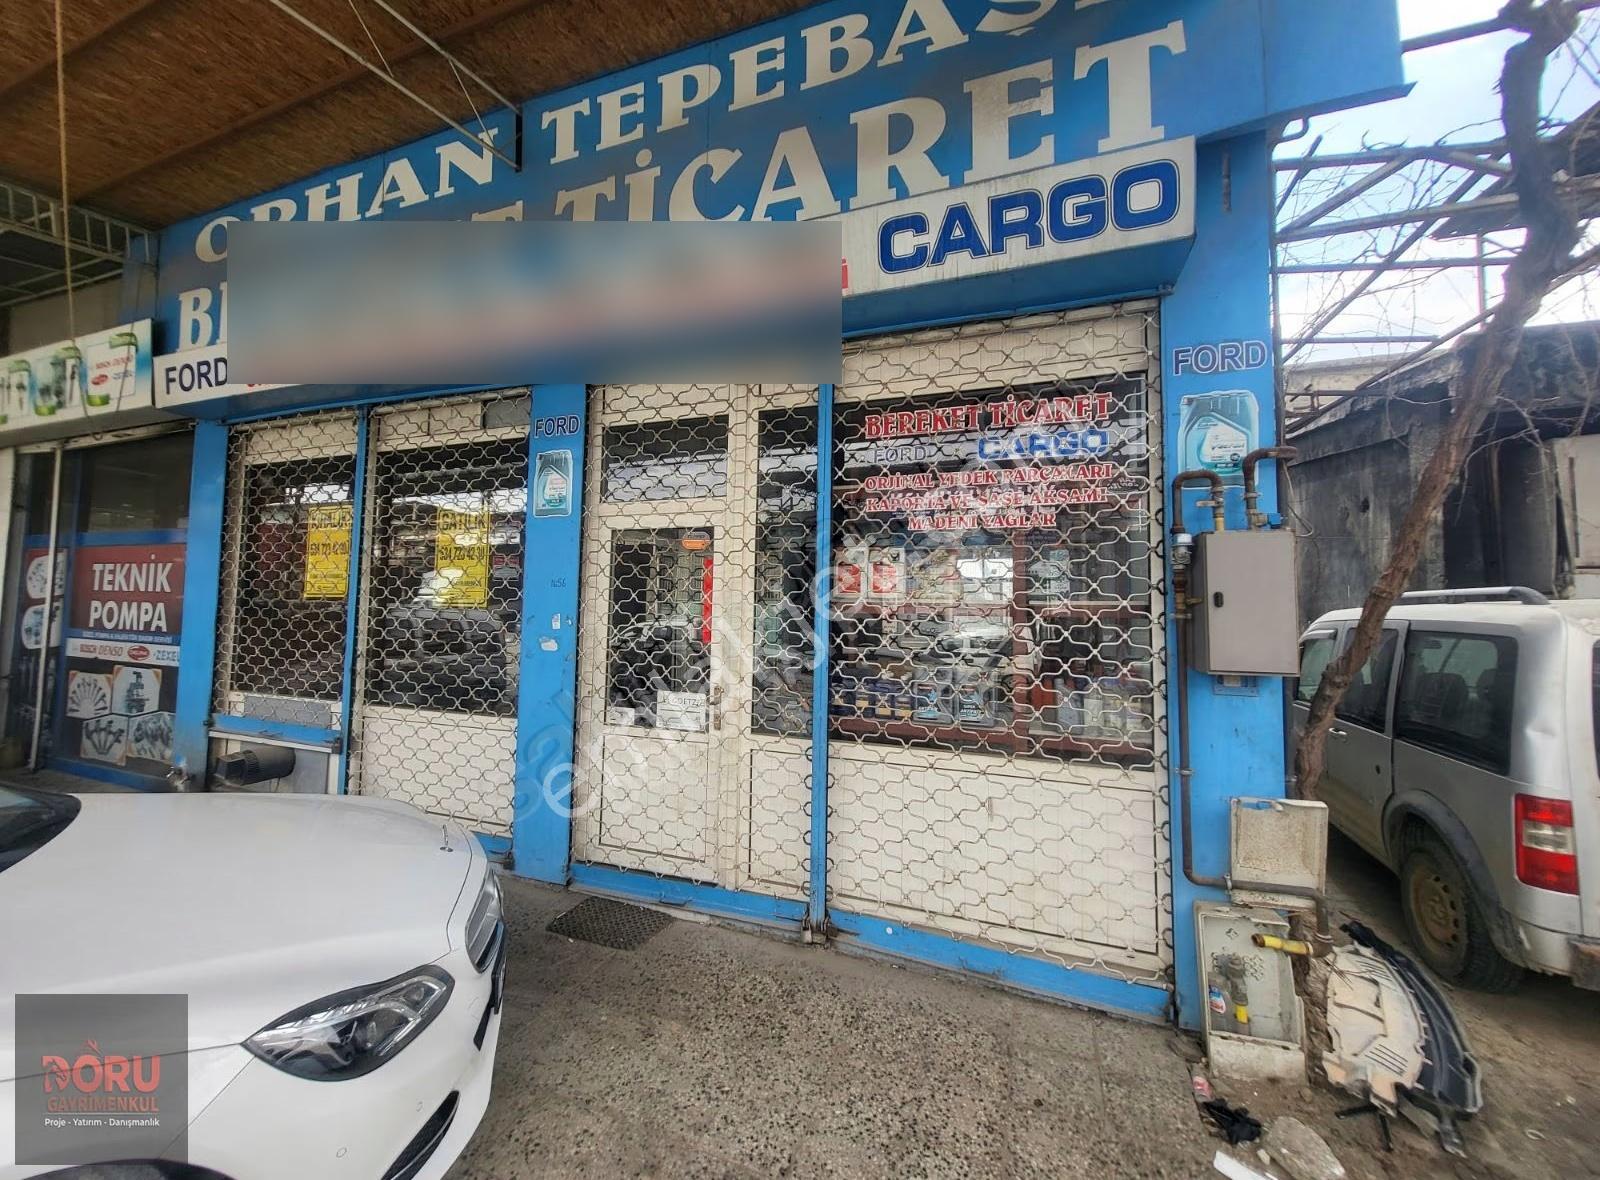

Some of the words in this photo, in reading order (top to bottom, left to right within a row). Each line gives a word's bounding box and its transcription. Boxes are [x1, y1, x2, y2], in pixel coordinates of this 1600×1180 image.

[554, 20, 1187, 221] TİCARET
[878, 158, 1180, 275] CARGO
[165, 356, 228, 395] FORD
[1172, 340, 1268, 377] FORD
[534, 415, 581, 438] FORD
[865, 404, 982, 439] BEREKET
[988, 393, 1113, 428] TİCARET
[873, 446, 927, 464] FORD
[978, 428, 1110, 461] CARGO
[92, 553, 173, 593] TEKNİK
[88, 600, 168, 633] POMPA
